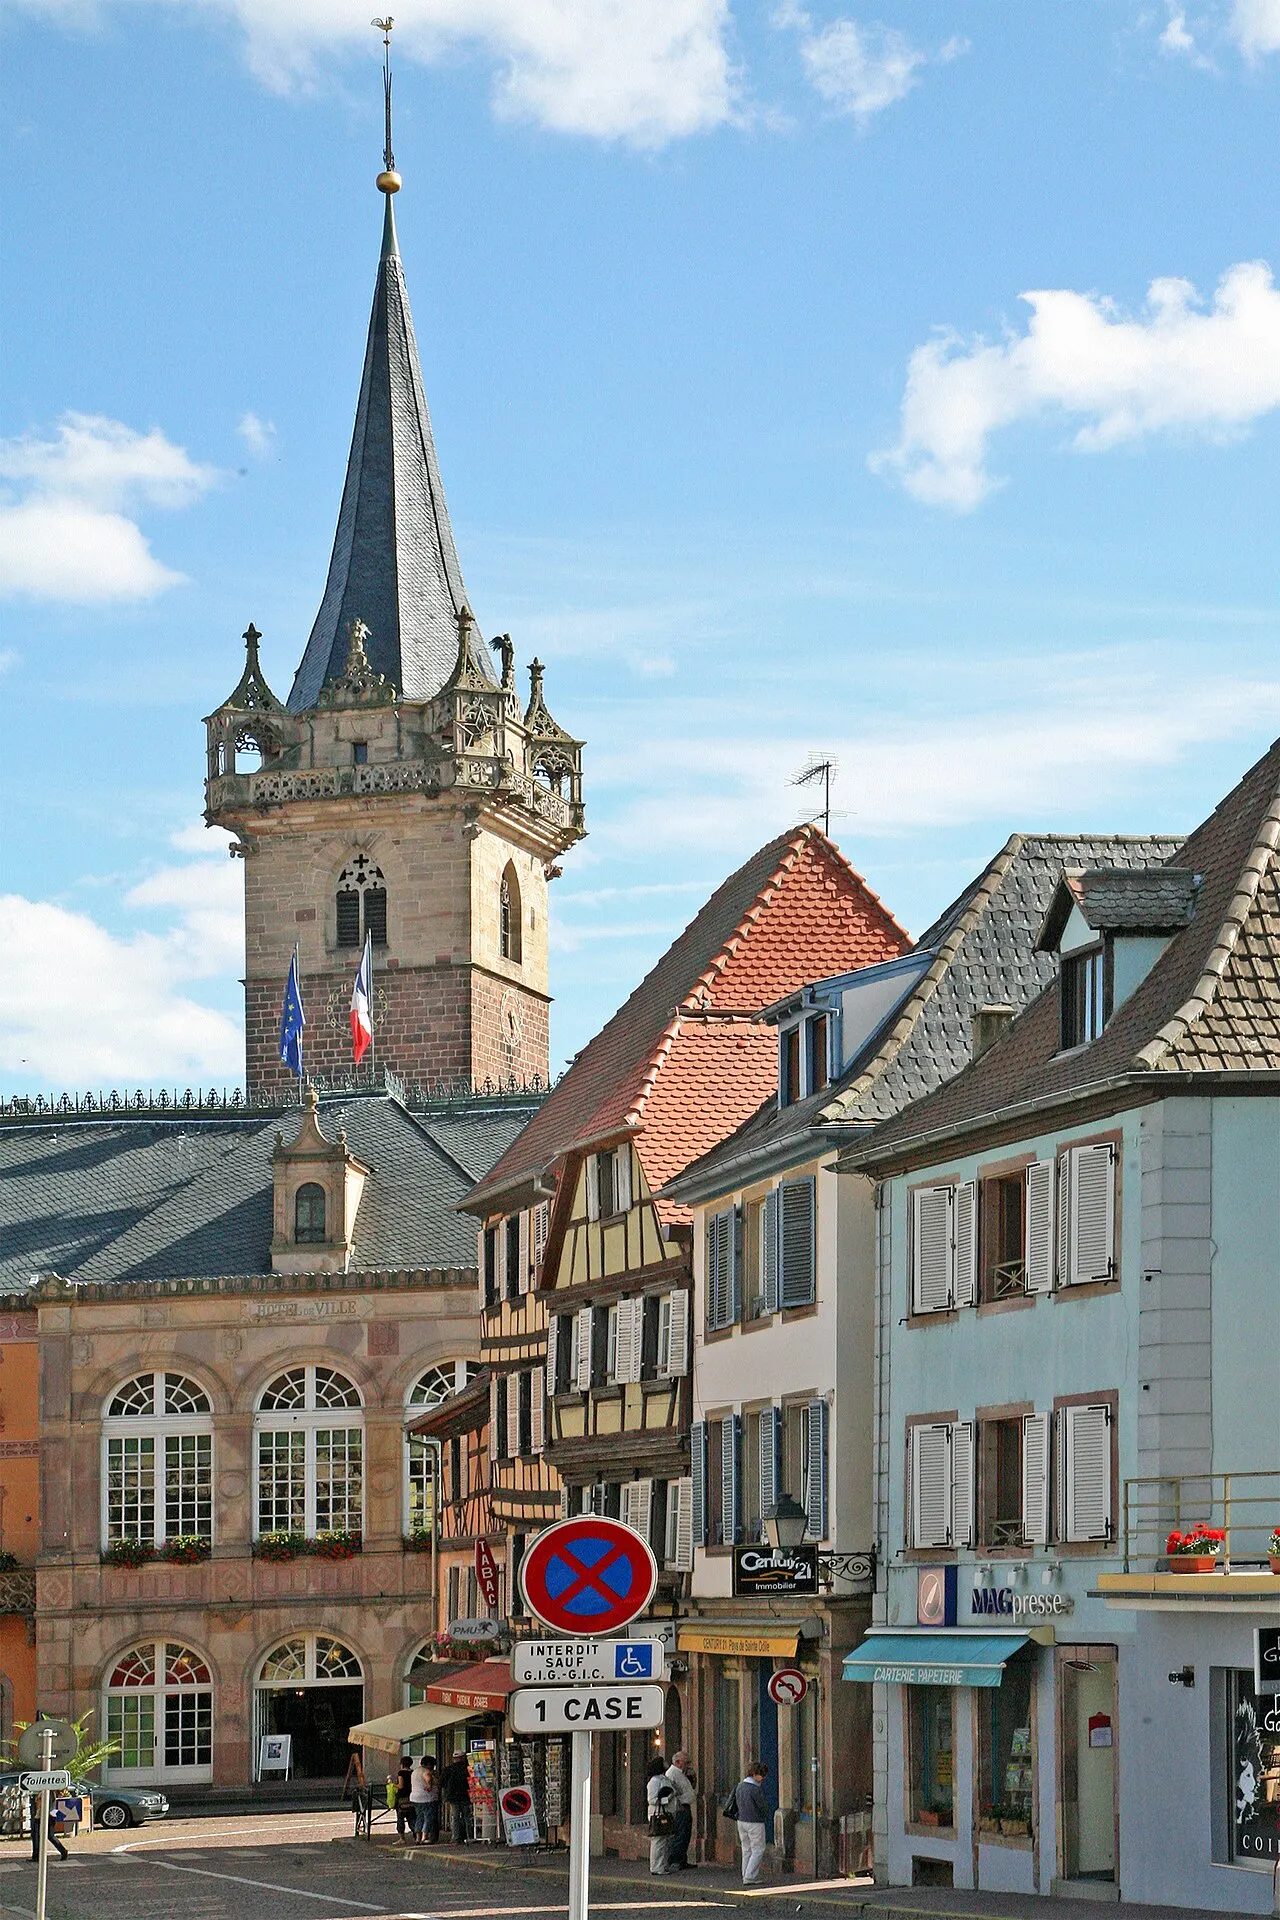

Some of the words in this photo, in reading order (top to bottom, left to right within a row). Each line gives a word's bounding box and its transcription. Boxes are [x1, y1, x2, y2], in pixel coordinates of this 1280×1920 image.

[340, 983, 347, 993] 11
[314, 1301, 357, 1315] VILLE
[478, 1540, 496, 1605] TABAC
[794, 1562, 812, 1580] 21
[971, 1587, 1062, 1624] MAGpresse
[452, 1626, 478, 1636] PMU
[530, 1644, 599, 1656] INTERDIT
[703, 1637, 721, 1650] CENTURY
[545, 1656, 584, 1668] SAUF
[524, 1669, 605, 1681] G.I.G.-G.I.C.
[873, 1667, 916, 1682] CARTERIE
[917, 1668, 964, 1684] PAPETERIE
[534, 1699, 546, 1722] 1
[563, 1696, 643, 1722] CASE
[25, 1777, 66, 1785] Toilettes
[1242, 1834, 1280, 1853] COI
